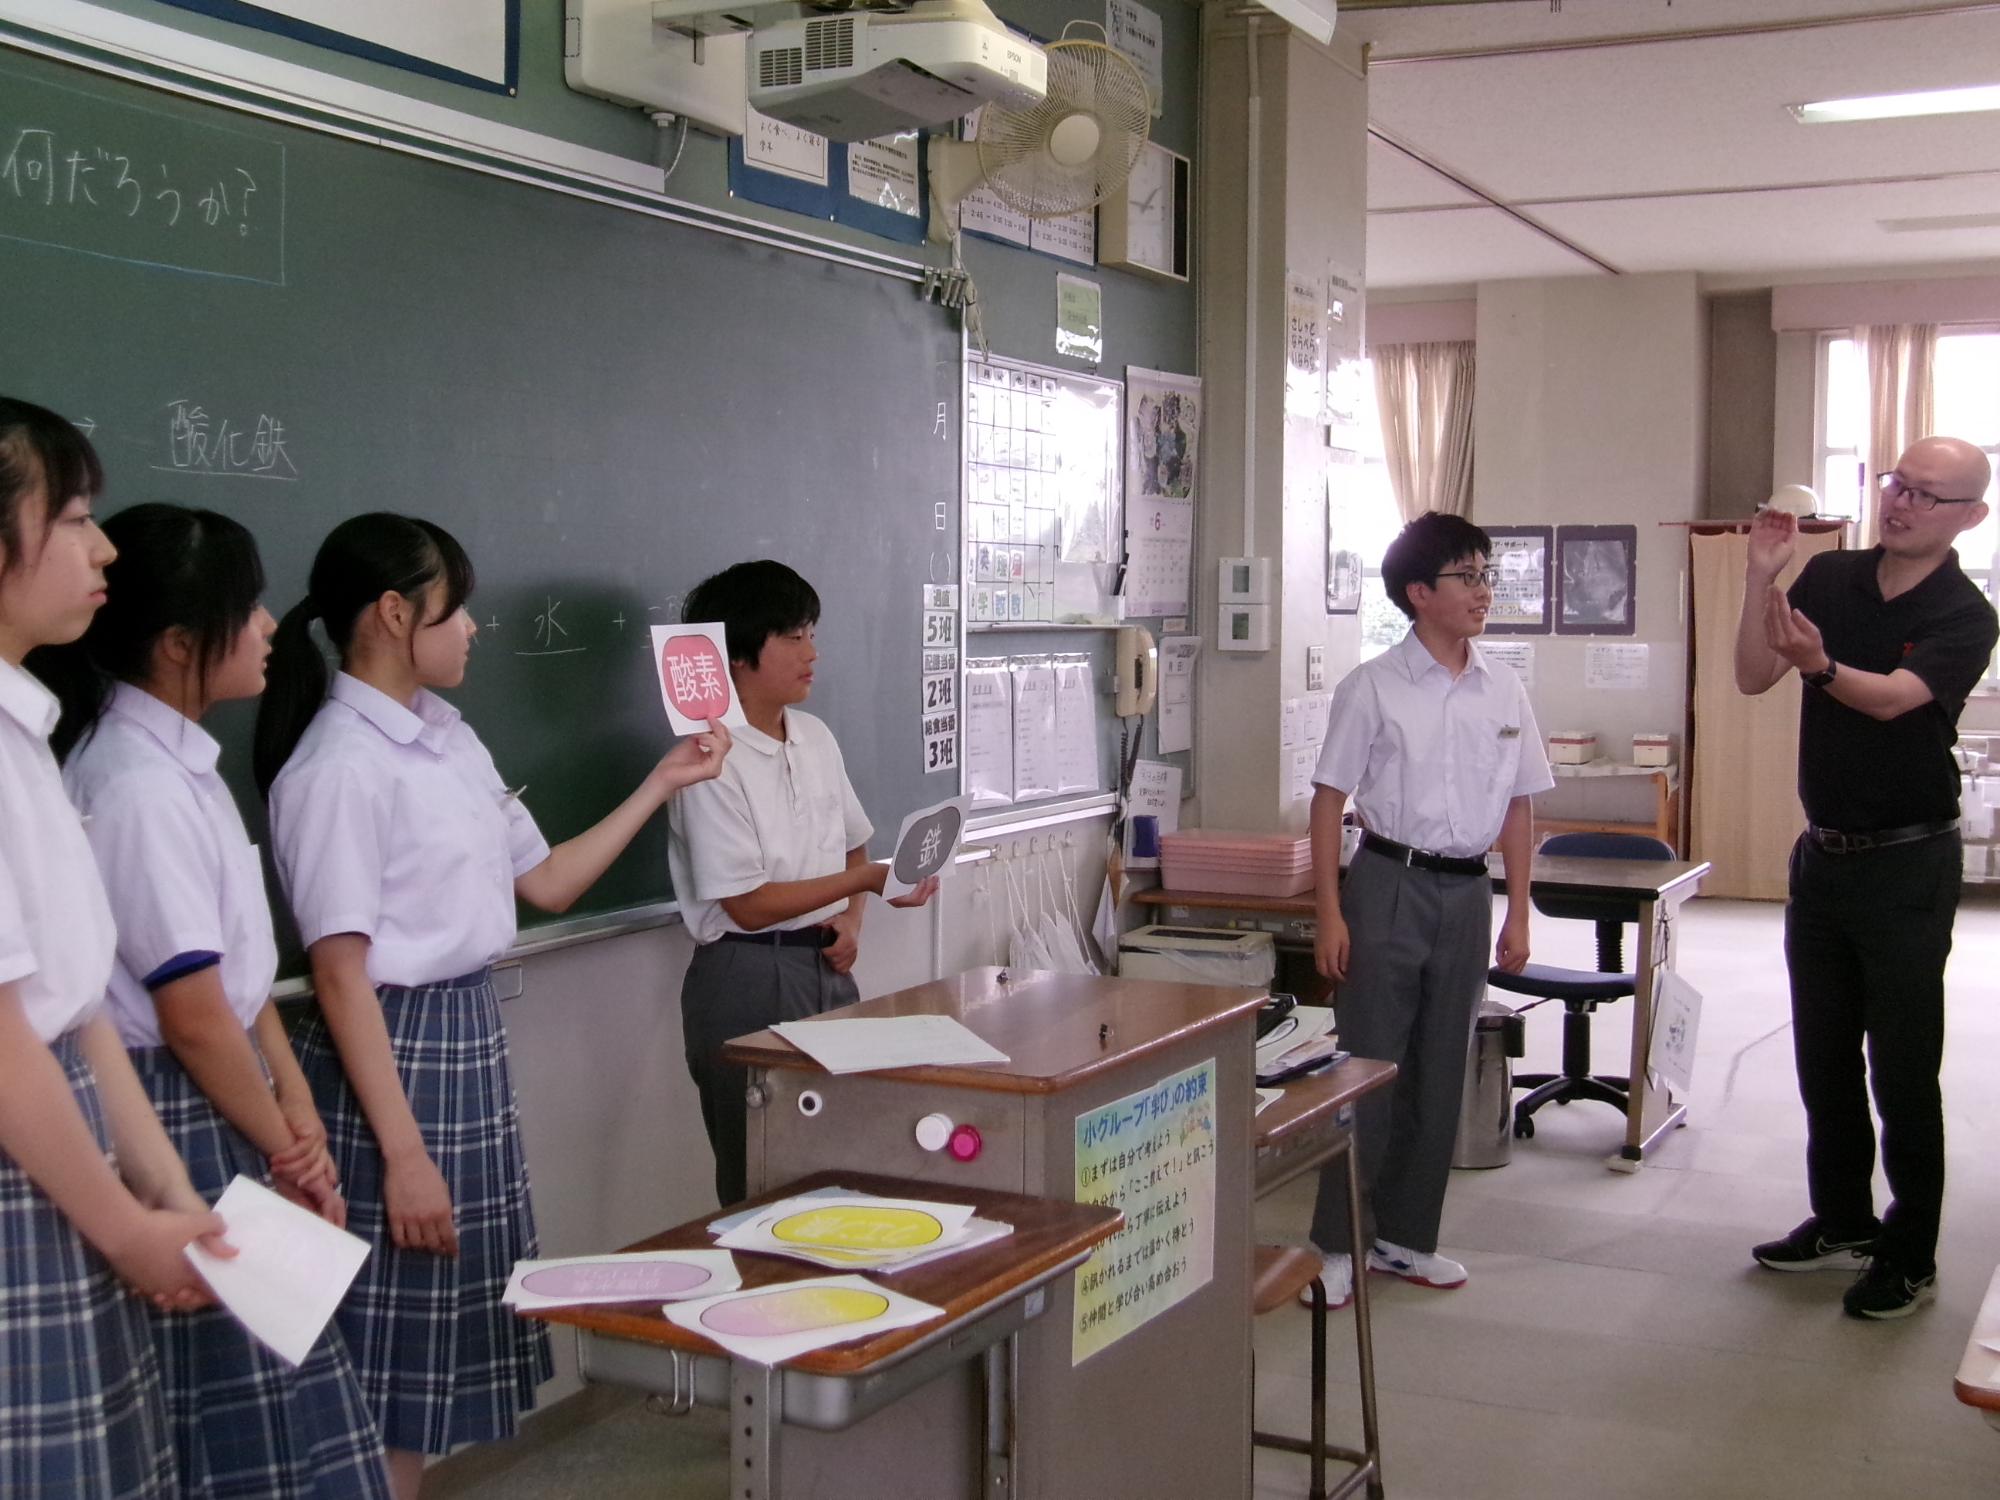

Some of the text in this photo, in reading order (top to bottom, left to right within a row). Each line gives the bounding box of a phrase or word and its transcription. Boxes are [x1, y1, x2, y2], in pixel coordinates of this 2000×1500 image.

[2, 129, 257, 236] 何だろうか?
[168, 399, 297, 474] 酸化鉄
[933, 401, 946, 440] 月
[934, 502, 946, 531] 日
[534, 595, 568, 647] 水
[927, 615, 952, 643] 5班
[666, 652, 723, 704] 酸素
[927, 677, 952, 708] 2班
[924, 713, 956, 736] 給食当番
[929, 737, 953, 768] 3班
[917, 824, 942, 869] 鉄
[1083, 1071, 1208, 1148] 小グループ「学び」の約束
